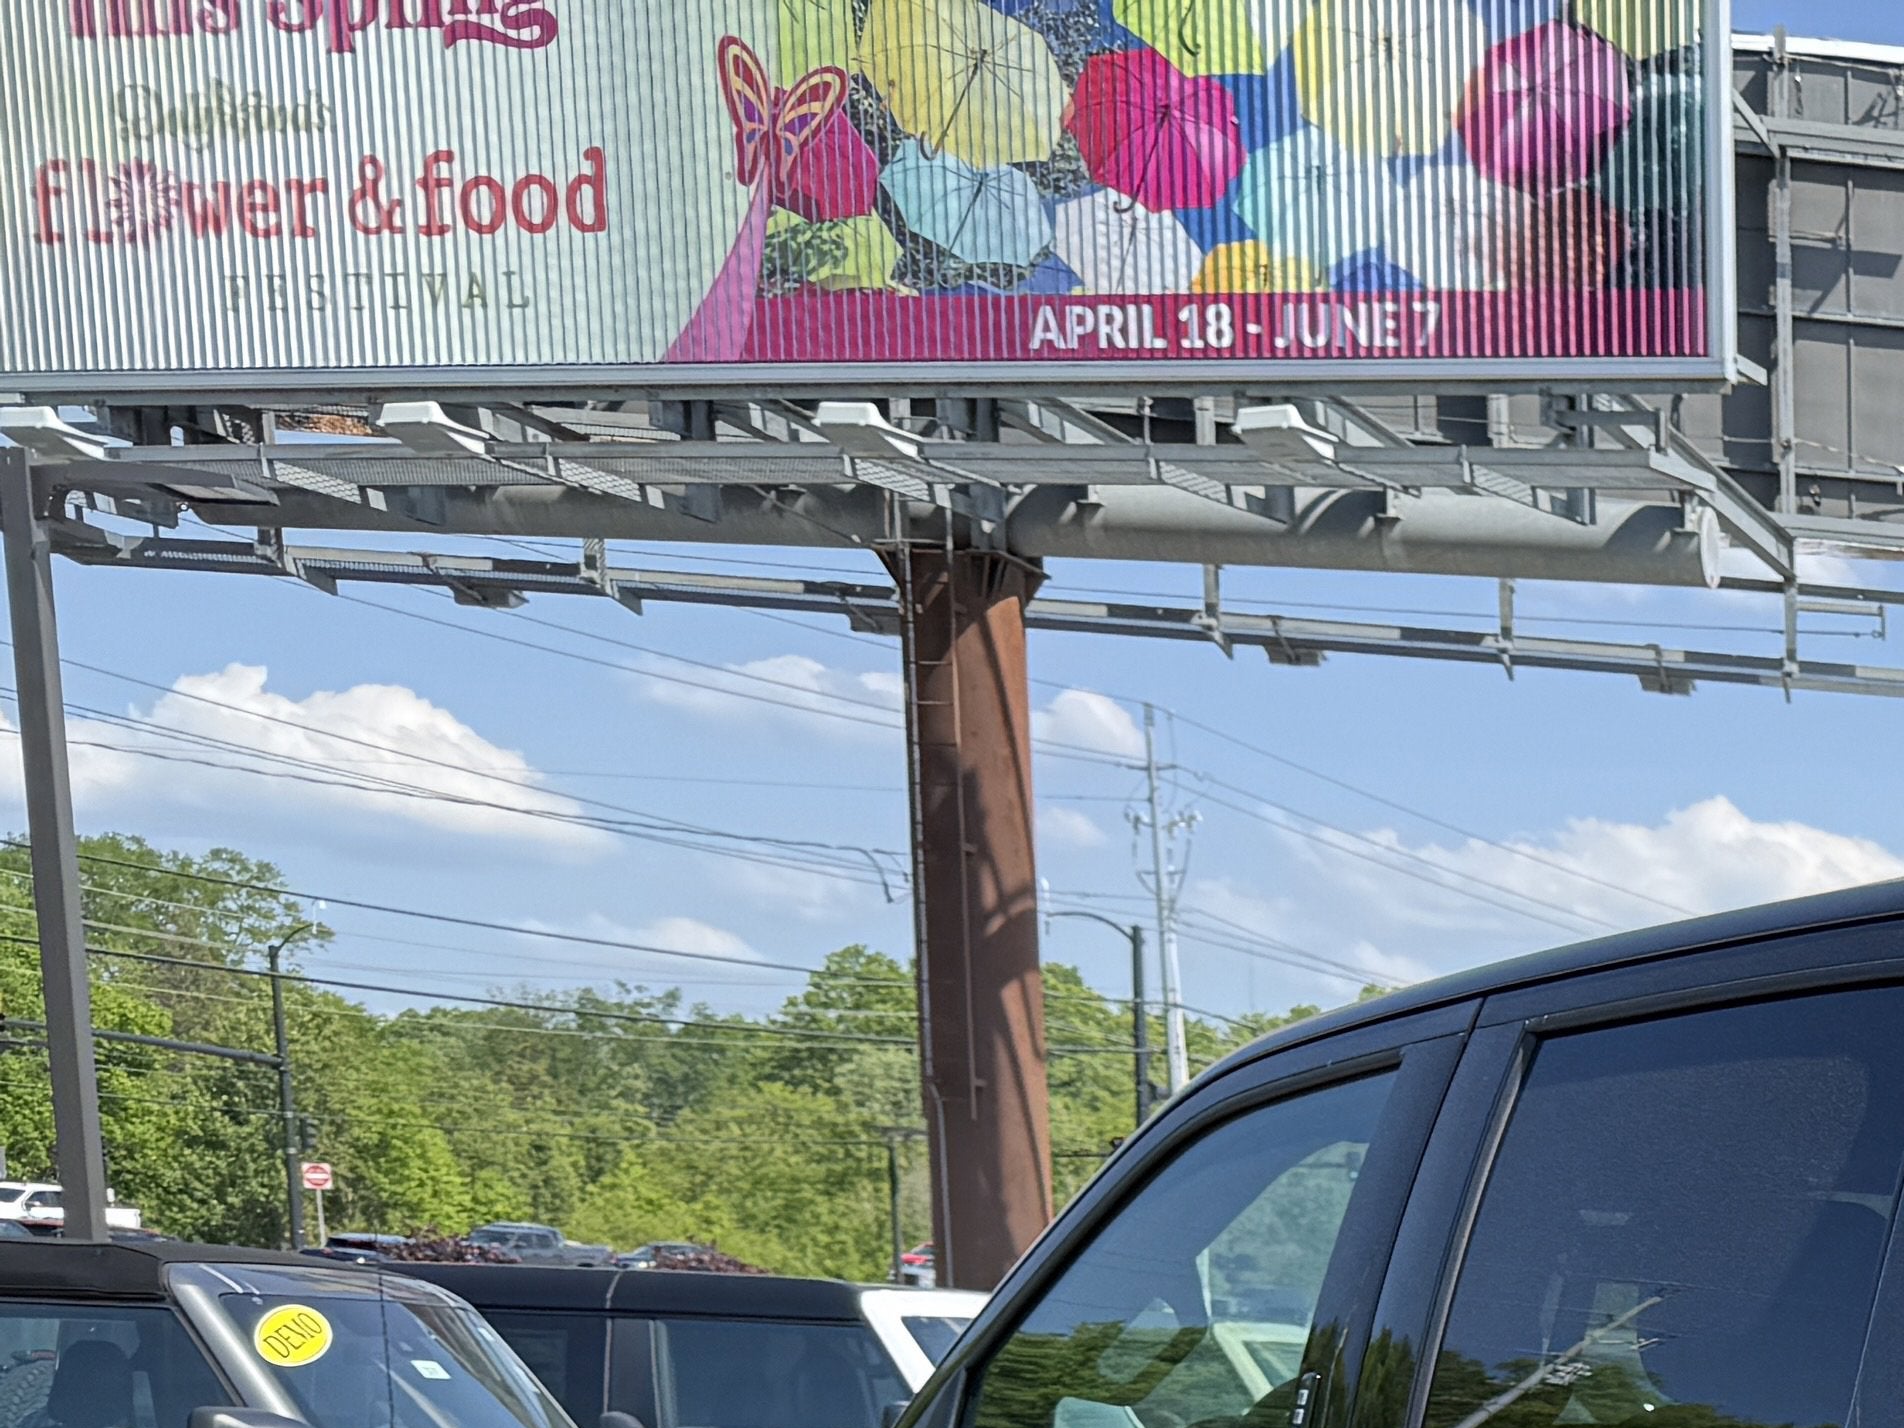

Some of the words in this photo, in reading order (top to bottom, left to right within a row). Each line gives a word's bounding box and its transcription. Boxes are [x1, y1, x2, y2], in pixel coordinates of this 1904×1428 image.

[347, 154, 403, 235] &
[413, 145, 607, 236] food
[223, 270, 531, 313] FESTIVAL
[1029, 303, 1167, 350] APRIL
[1178, 302, 1232, 349] 18
[1274, 302, 1399, 349] JUNE
[1412, 300, 1438, 346] 7
[263, 1312, 323, 1358] DEMO
